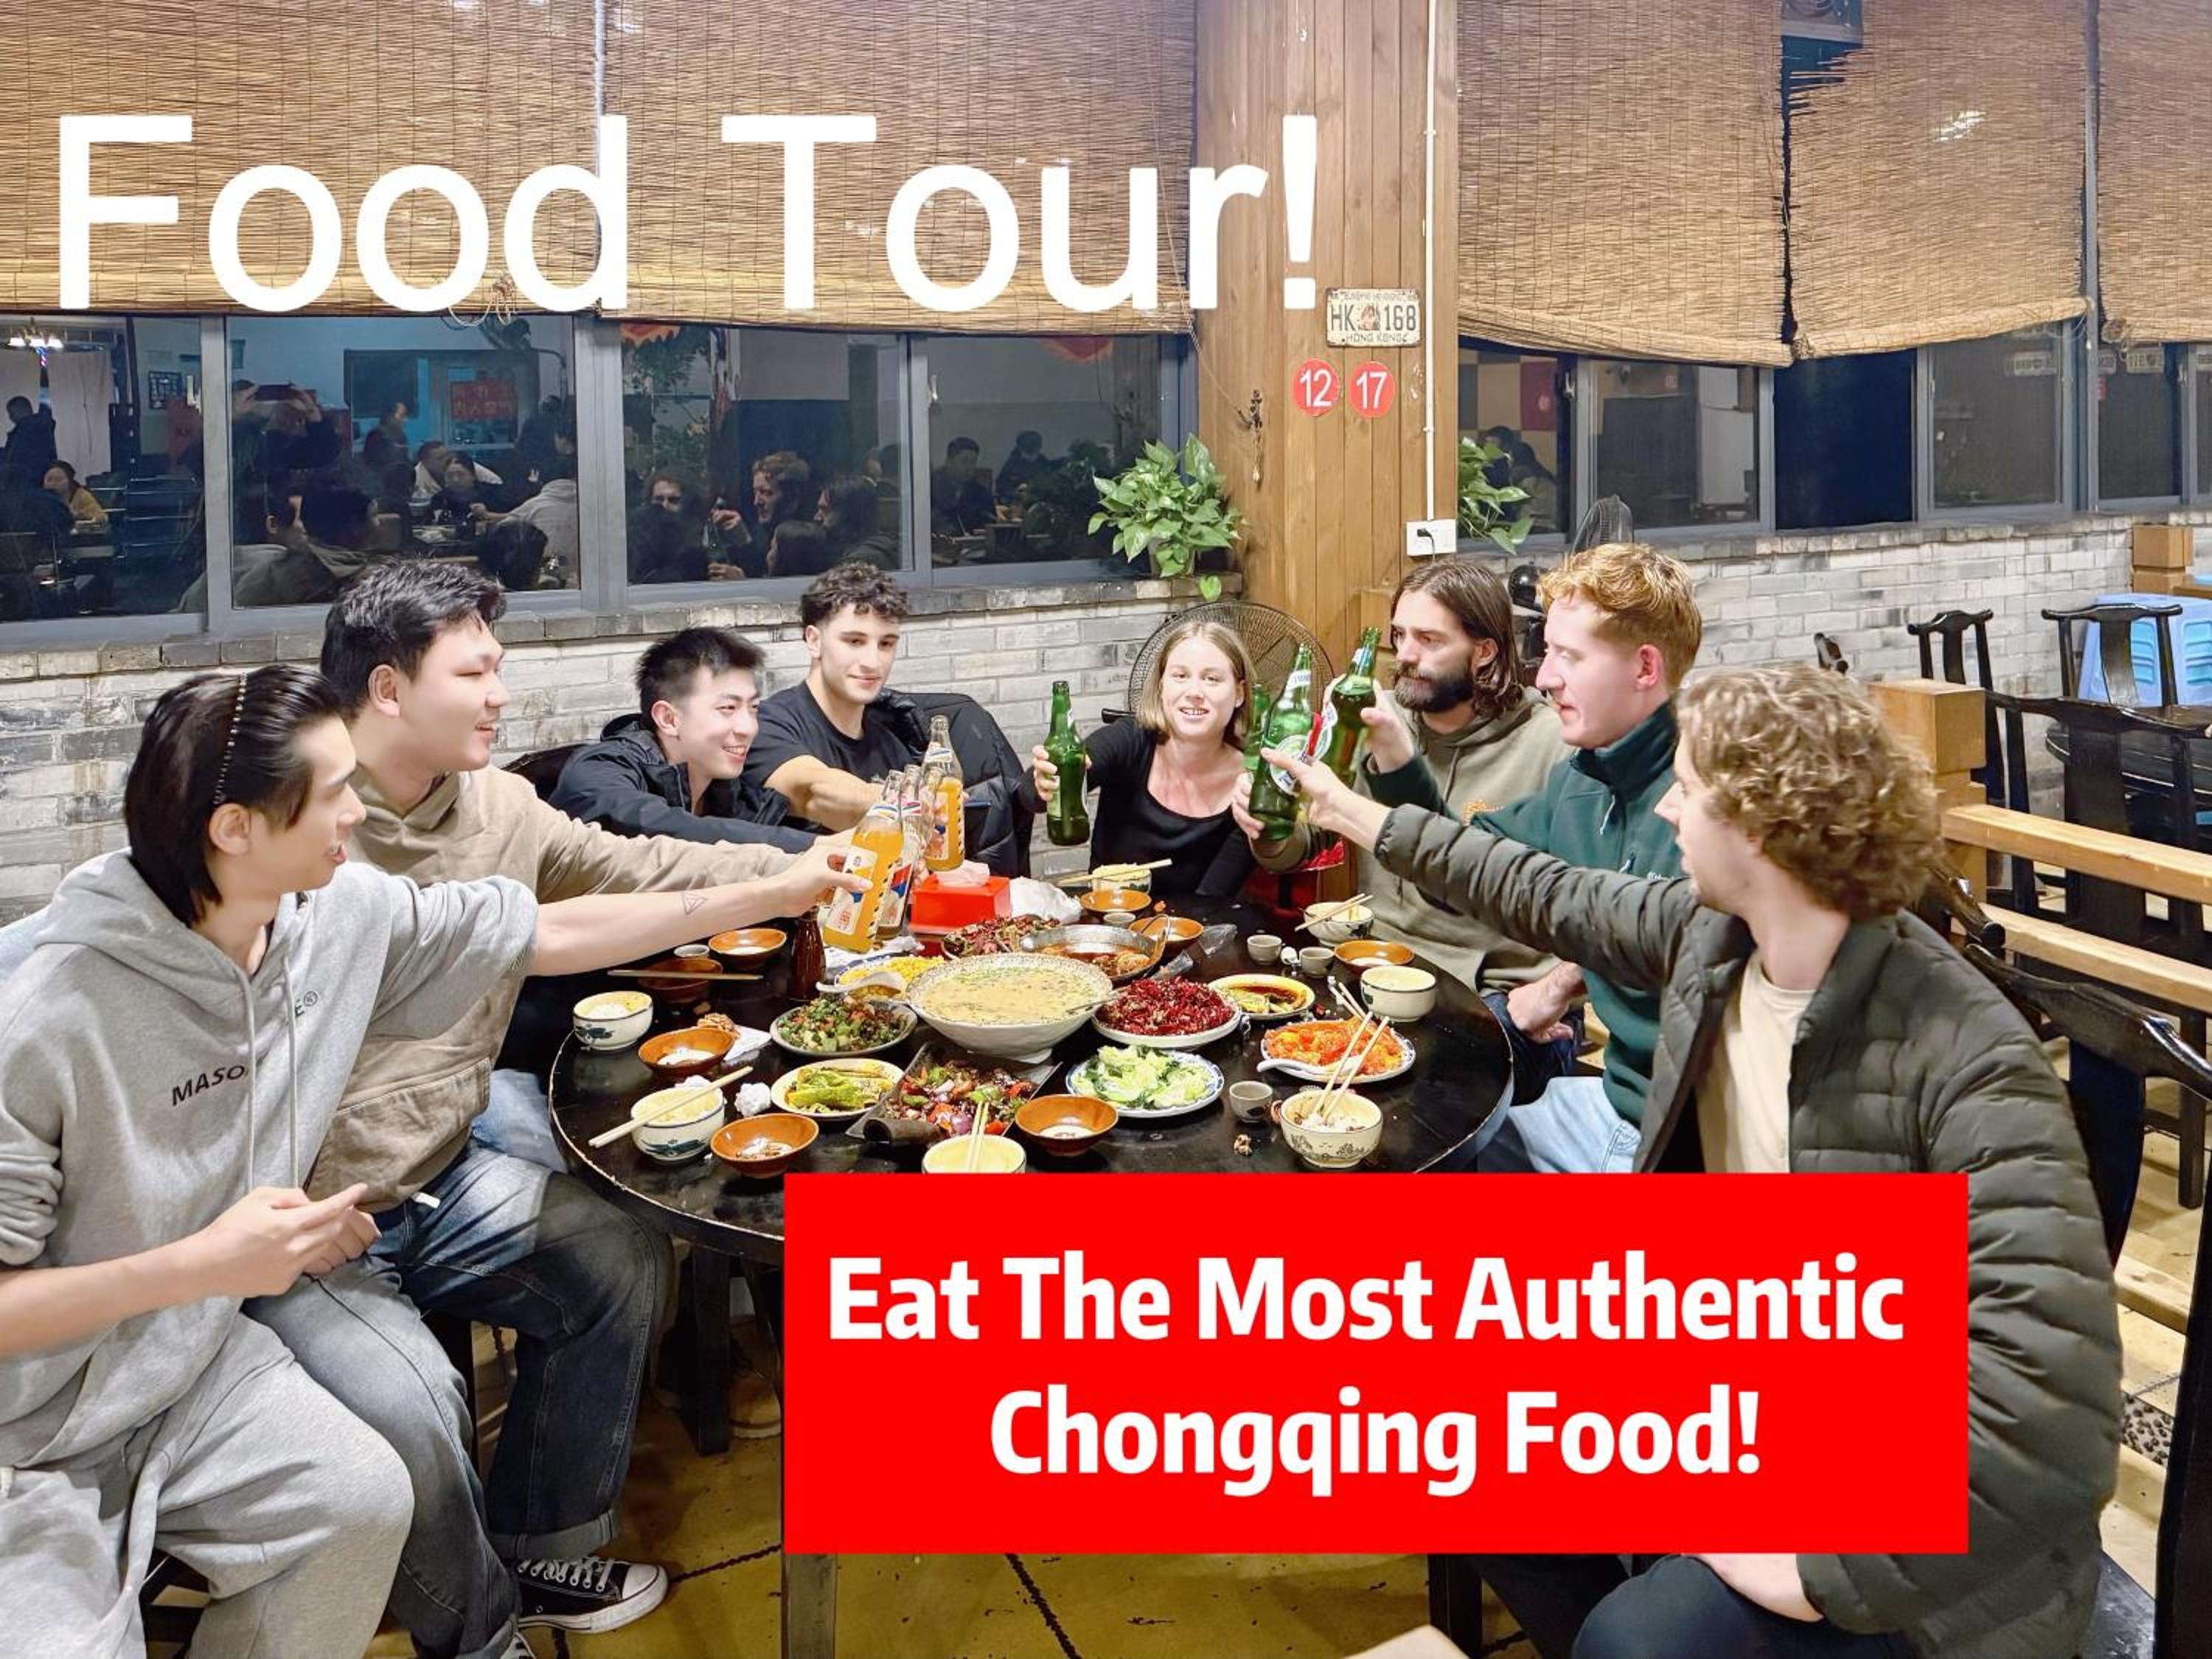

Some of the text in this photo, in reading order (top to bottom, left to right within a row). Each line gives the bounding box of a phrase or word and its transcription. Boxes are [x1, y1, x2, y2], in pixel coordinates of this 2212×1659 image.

[1331, 305, 1416, 331] HK 168
[1300, 369, 1333, 407] 12
[1356, 371, 1388, 409] 17
[172, 1065, 249, 1106] MASO
